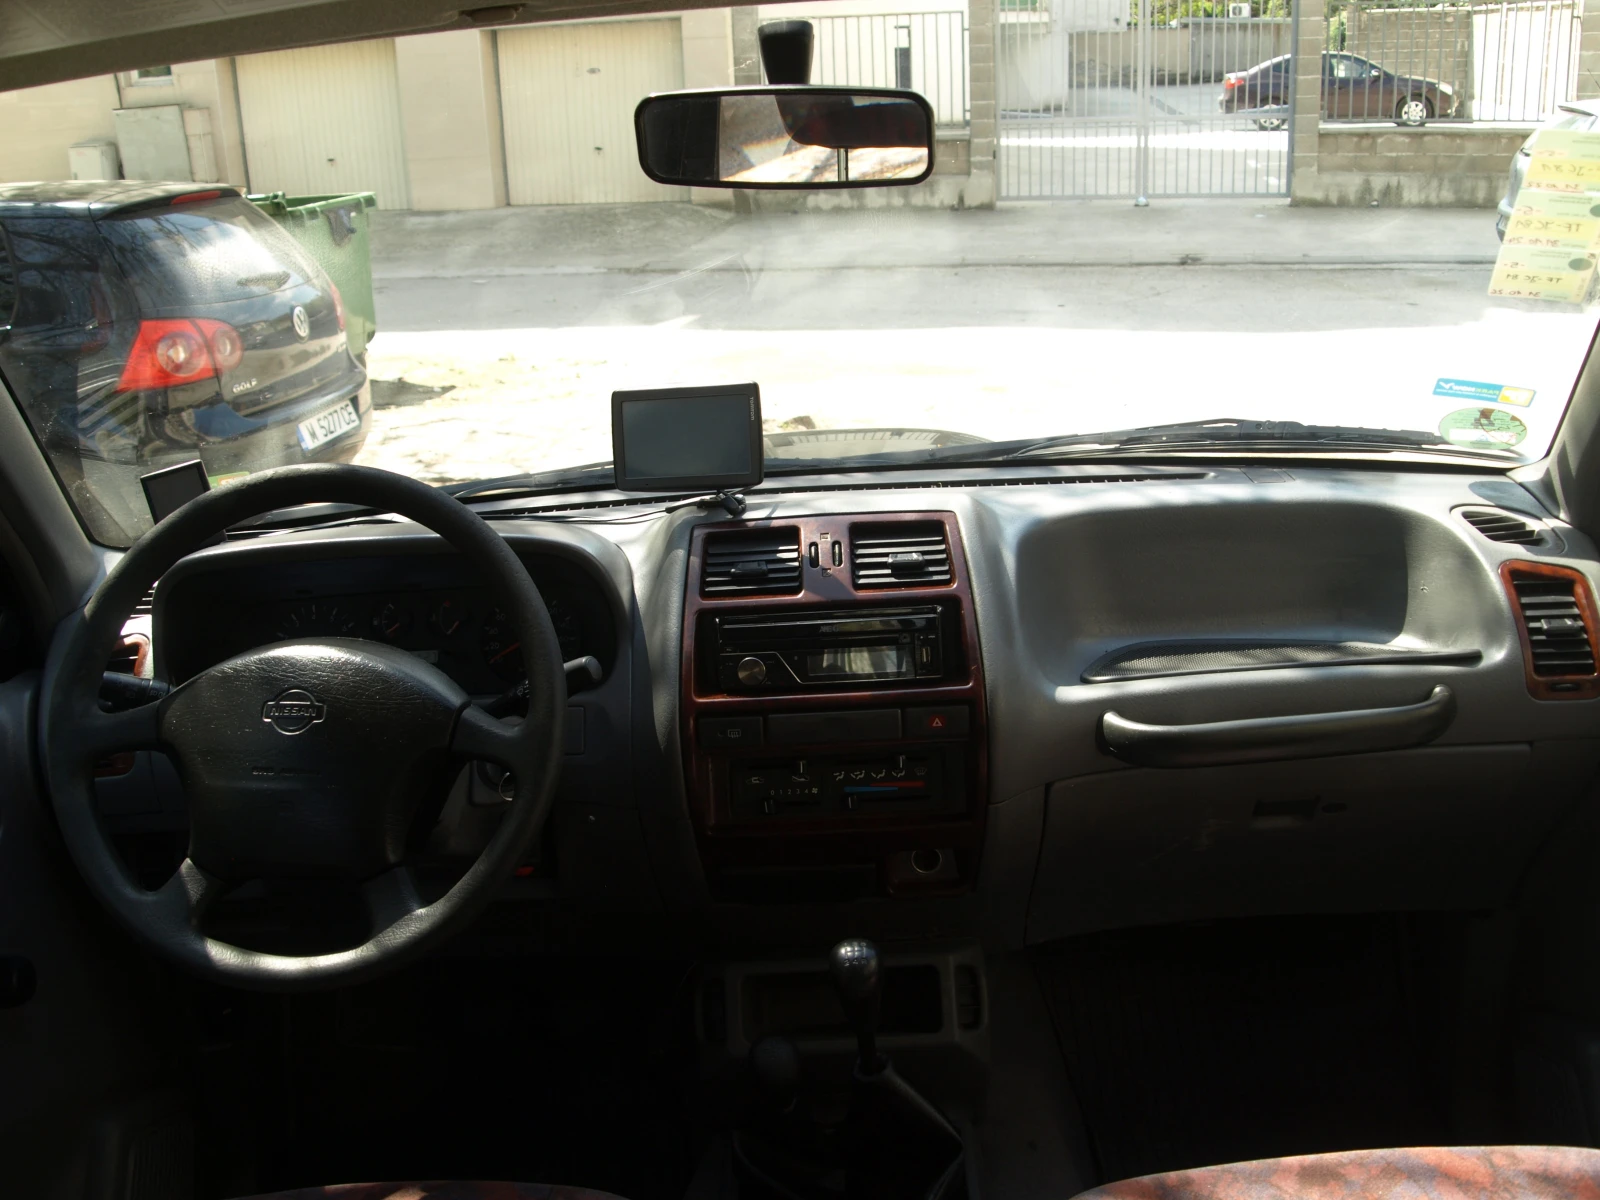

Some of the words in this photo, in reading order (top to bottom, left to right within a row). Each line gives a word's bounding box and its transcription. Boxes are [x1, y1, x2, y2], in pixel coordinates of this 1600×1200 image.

[232, 377, 258, 394] GOLF
[305, 422, 319, 444] M
[317, 409, 342, 437] 5277
[340, 403, 357, 425] CE
[270, 706, 317, 717] NISSAN
